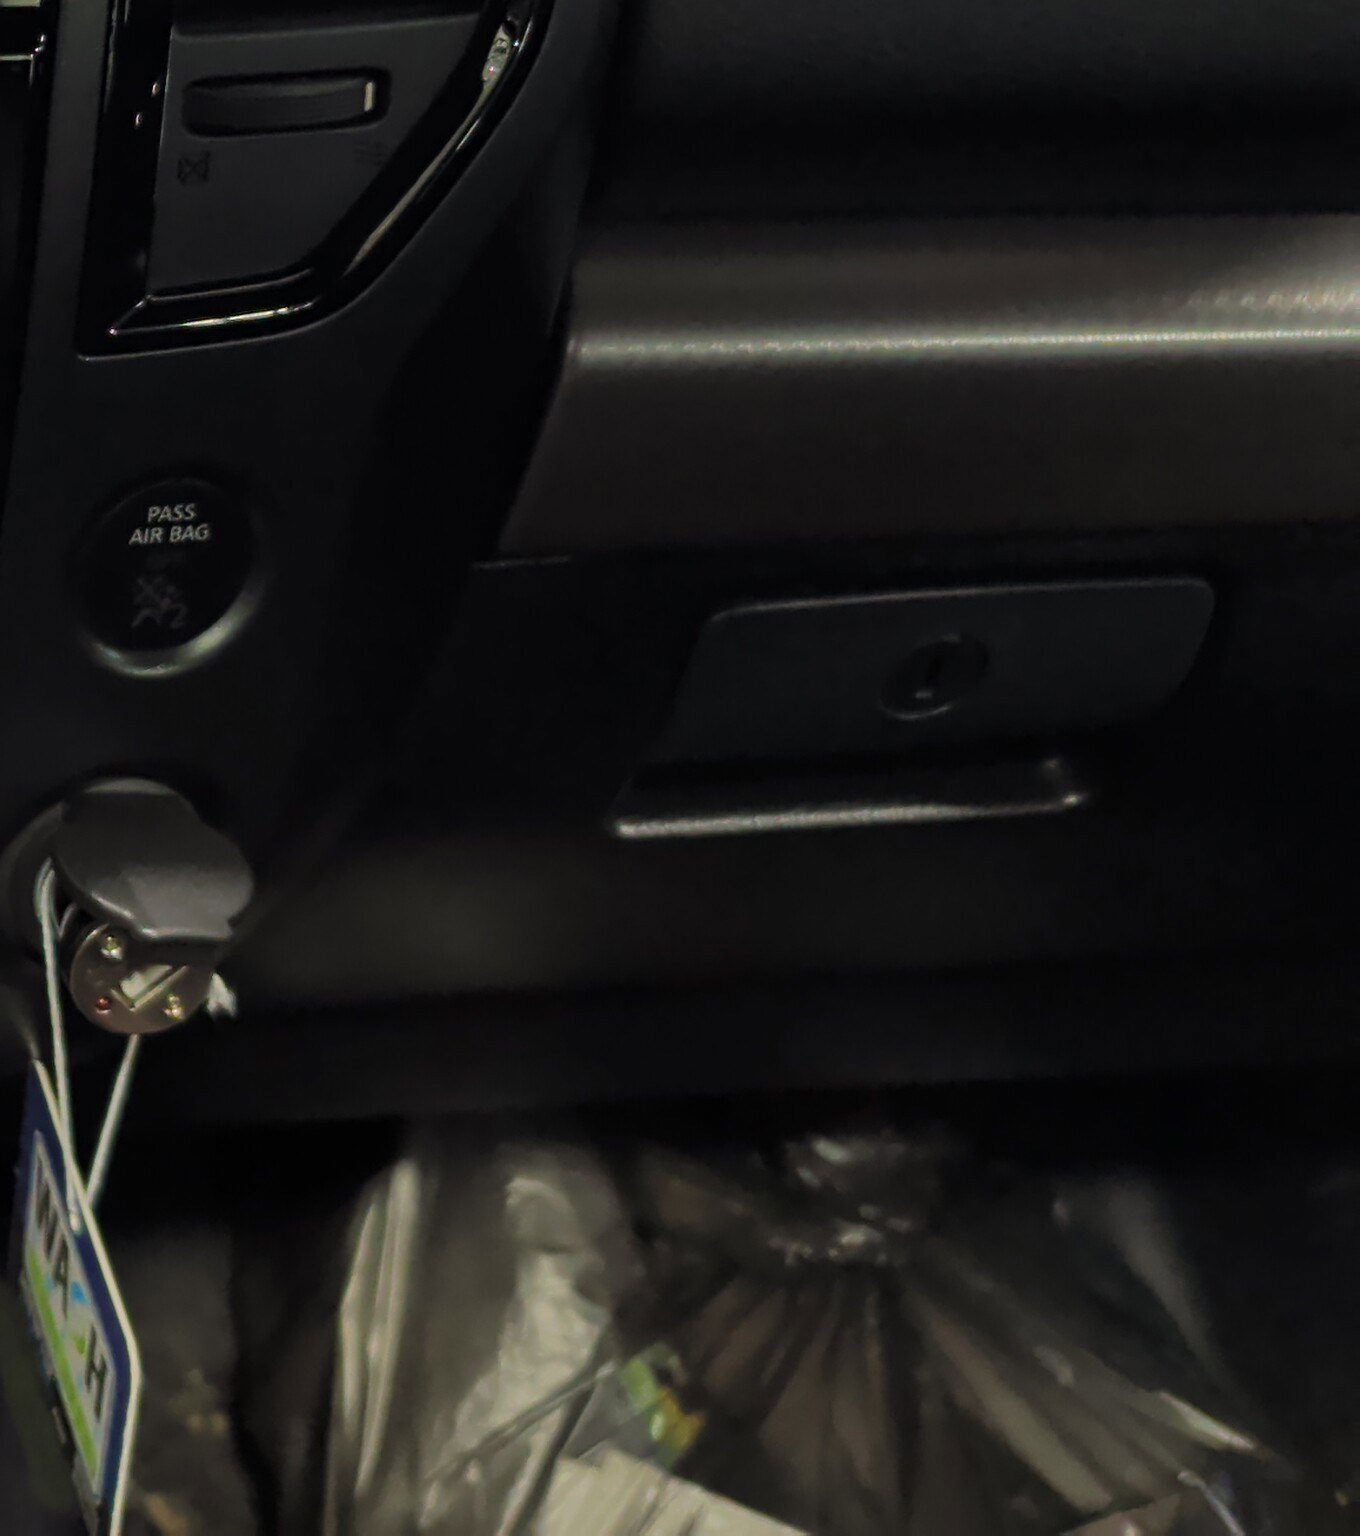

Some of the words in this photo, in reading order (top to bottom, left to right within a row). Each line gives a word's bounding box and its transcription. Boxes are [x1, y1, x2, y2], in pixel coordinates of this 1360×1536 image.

[147, 503, 198, 523] PASS
[128, 526, 164, 546] AIR
[169, 522, 212, 543] BAG
